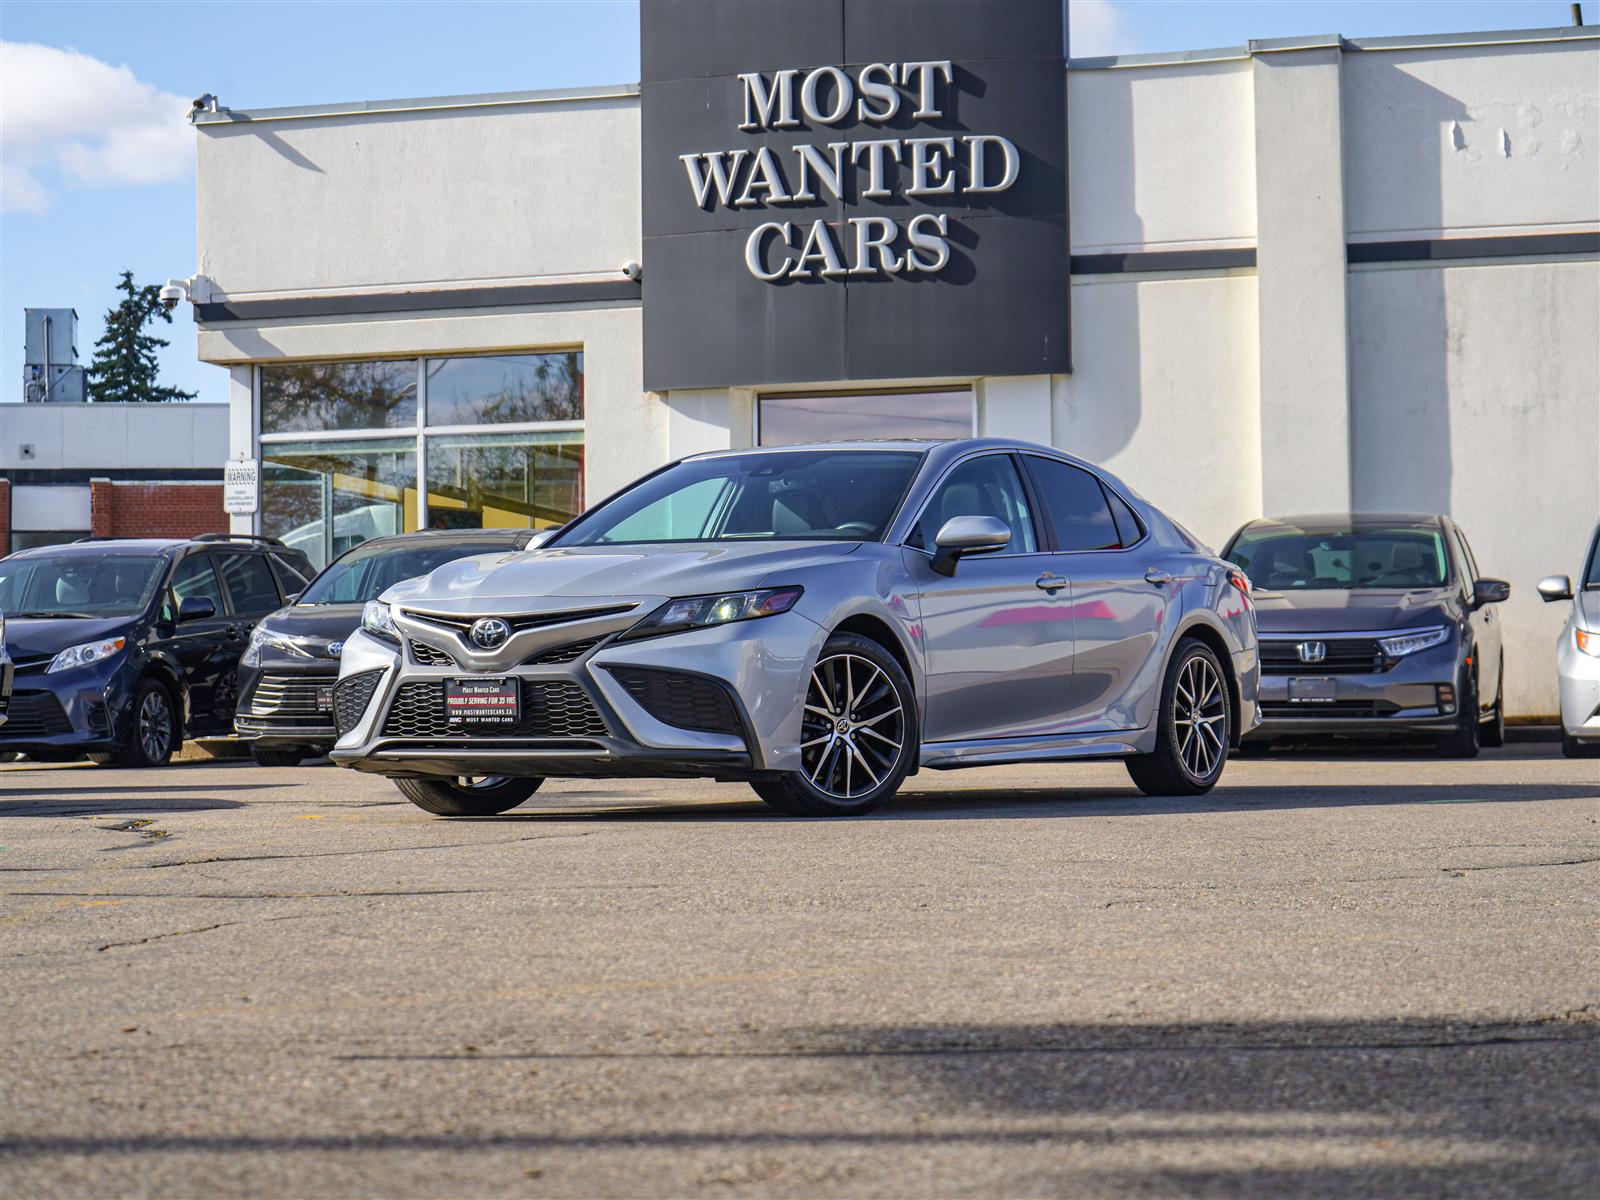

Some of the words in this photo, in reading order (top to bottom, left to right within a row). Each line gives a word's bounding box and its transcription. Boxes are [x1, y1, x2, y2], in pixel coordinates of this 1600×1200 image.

[737, 60, 953, 129] MOST
[679, 135, 1020, 208] WANTED
[745, 214, 950, 281] CARS
[227, 471, 256, 482] WARNING
